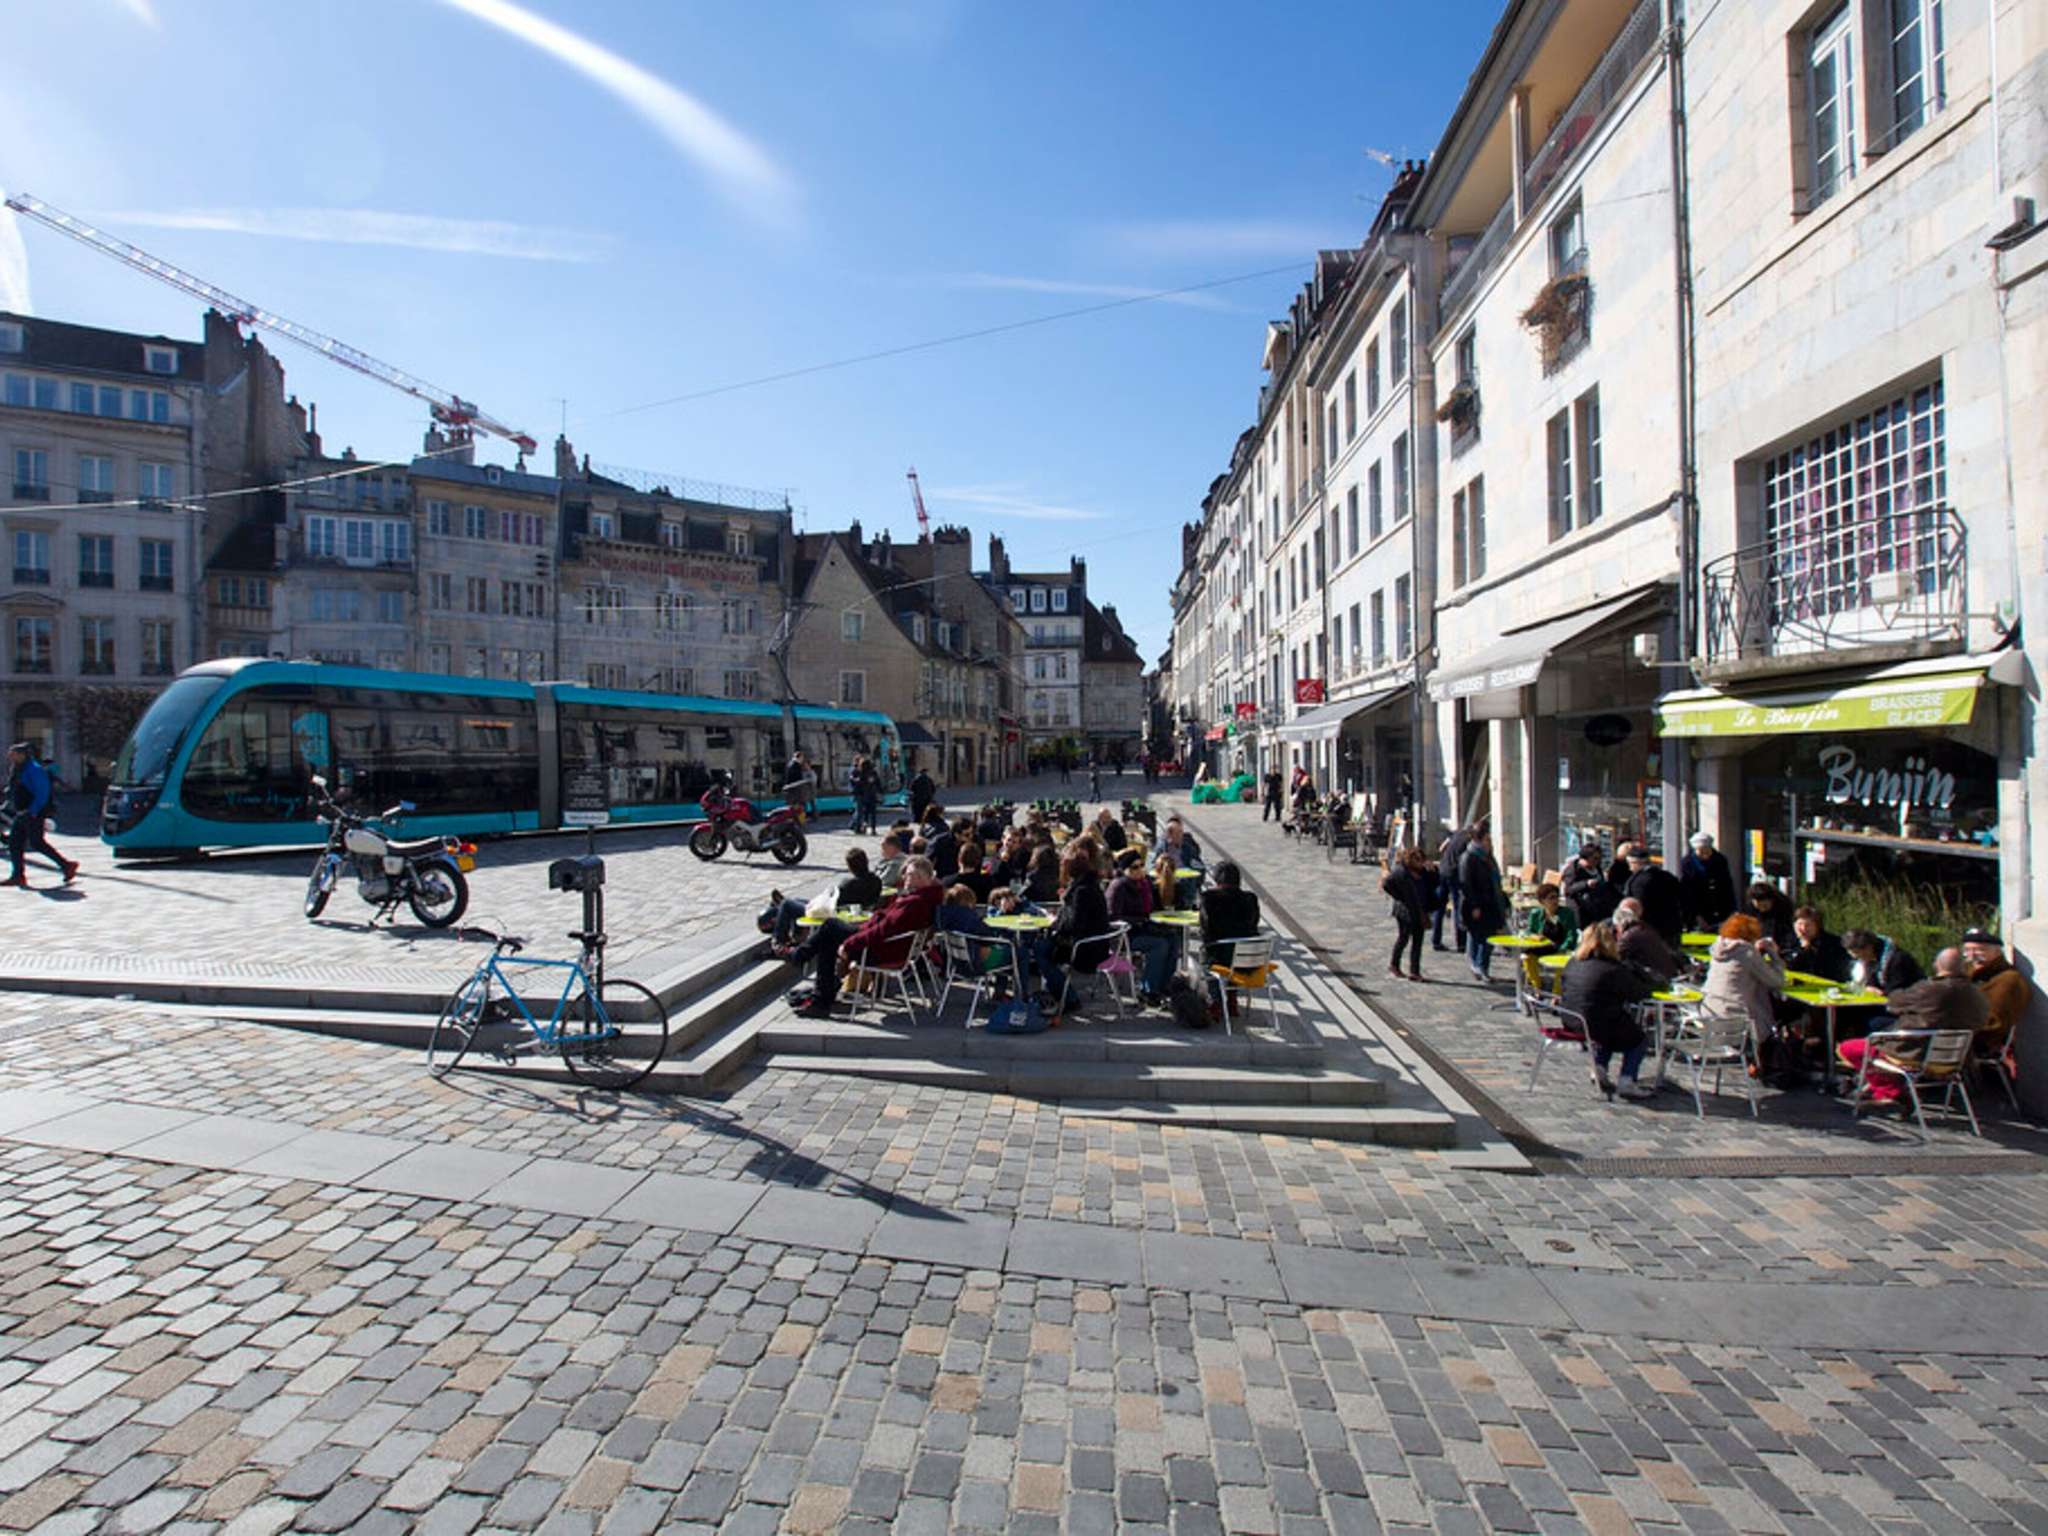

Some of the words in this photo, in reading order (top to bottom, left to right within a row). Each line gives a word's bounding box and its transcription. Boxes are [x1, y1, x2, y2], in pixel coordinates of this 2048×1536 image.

[1870, 692, 1944, 711] BRASSERIE
[1733, 708, 1757, 728] Le
[1764, 704, 1840, 728] Bunjin
[1887, 709, 1943, 725] GLACES
[1819, 745, 1955, 824] Bunjin
